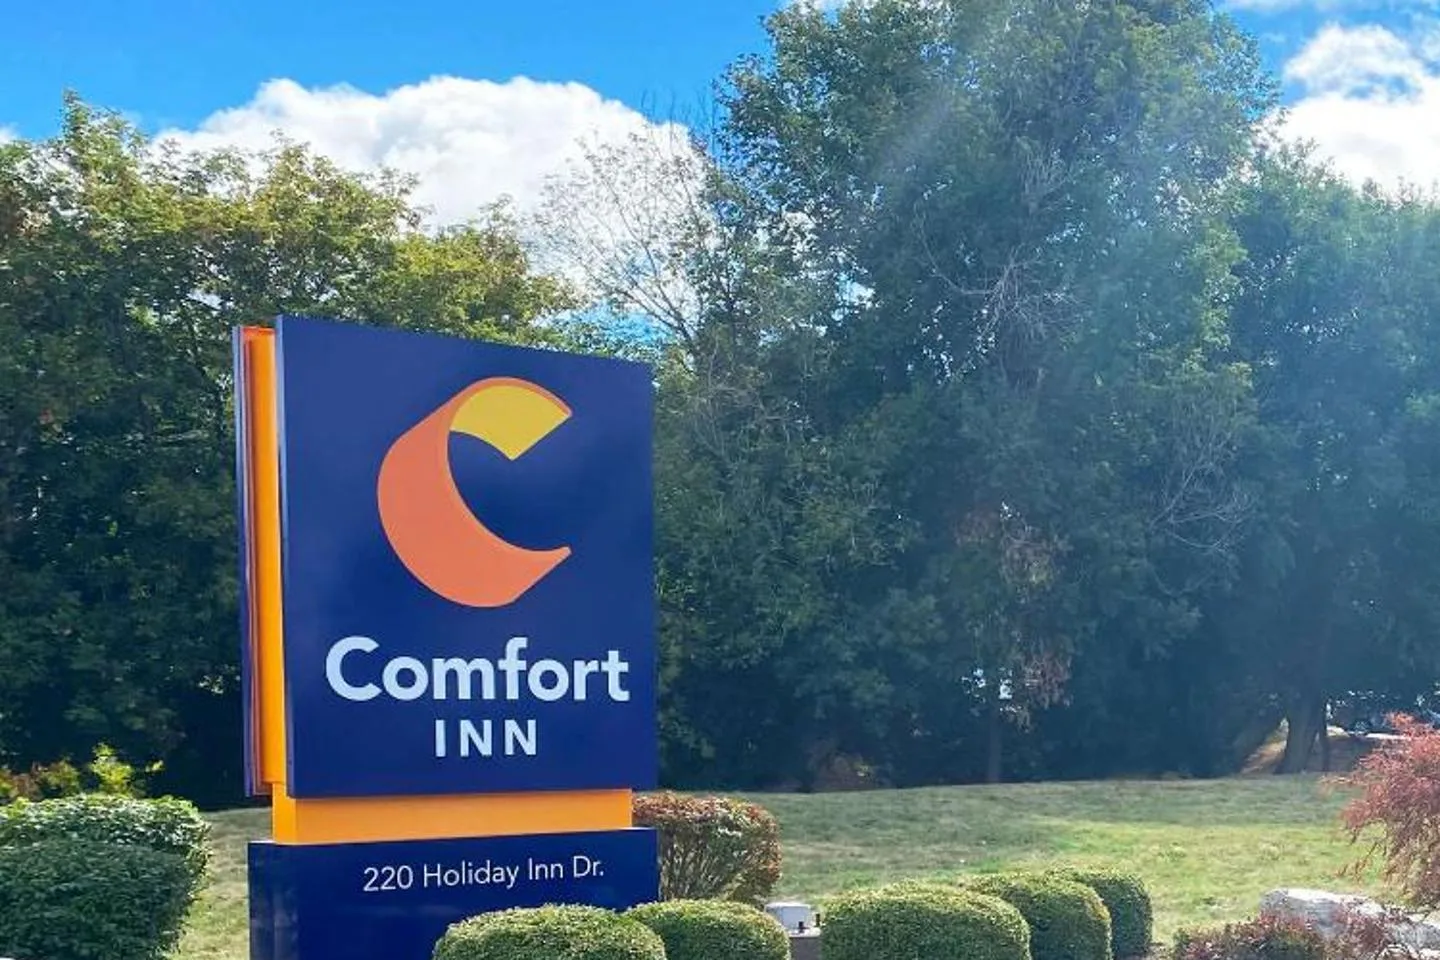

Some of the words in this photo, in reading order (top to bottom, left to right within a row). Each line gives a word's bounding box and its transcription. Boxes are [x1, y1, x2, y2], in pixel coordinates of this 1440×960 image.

[325, 635, 630, 702] Comfort
[435, 719, 537, 757] INN
[363, 865, 414, 892] 220
[423, 859, 520, 889] Holiday
[528, 857, 564, 880] Inn
[573, 855, 606, 878] Dr.
